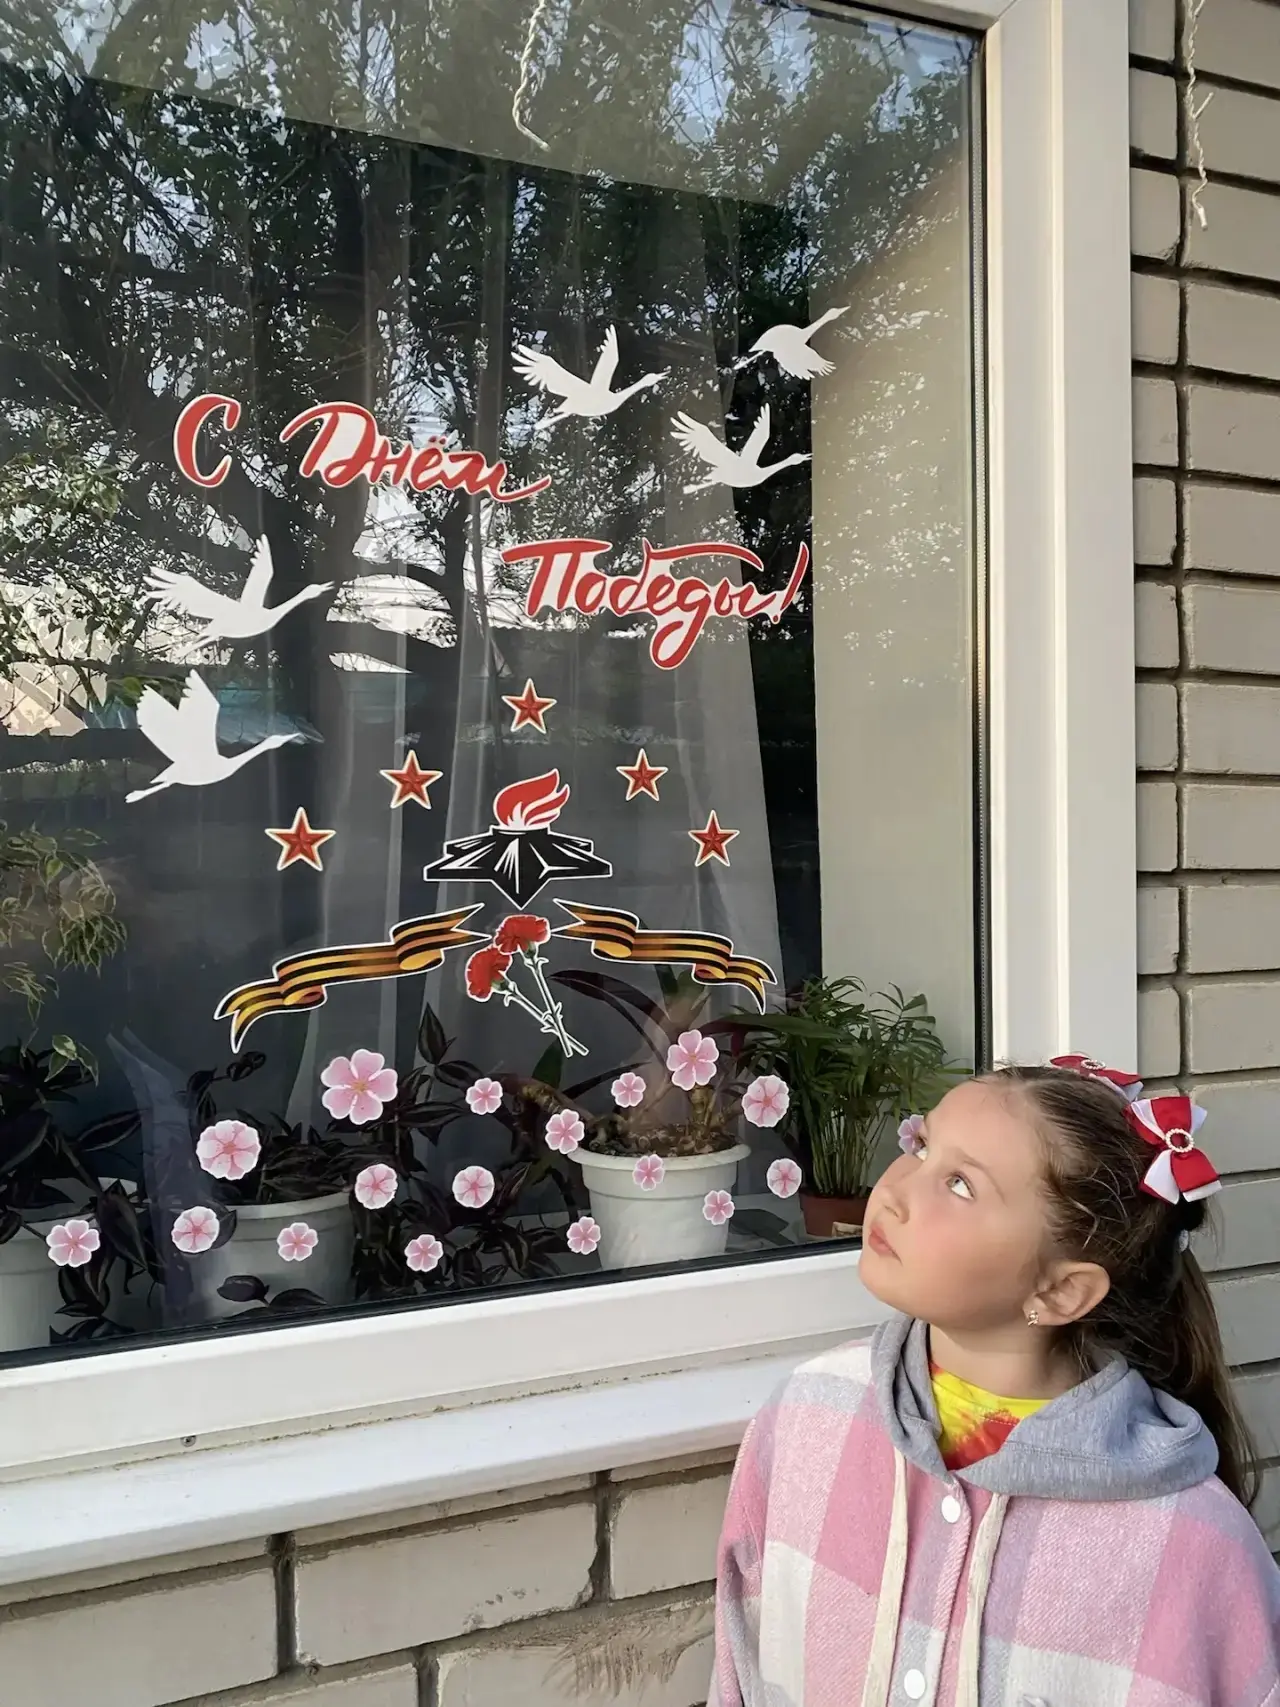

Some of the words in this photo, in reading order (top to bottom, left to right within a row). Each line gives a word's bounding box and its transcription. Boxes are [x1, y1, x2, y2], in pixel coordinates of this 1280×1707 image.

[174, 394, 241, 488] С
[279, 401, 552, 503] Днём
[501, 537, 810, 670] Победы!
